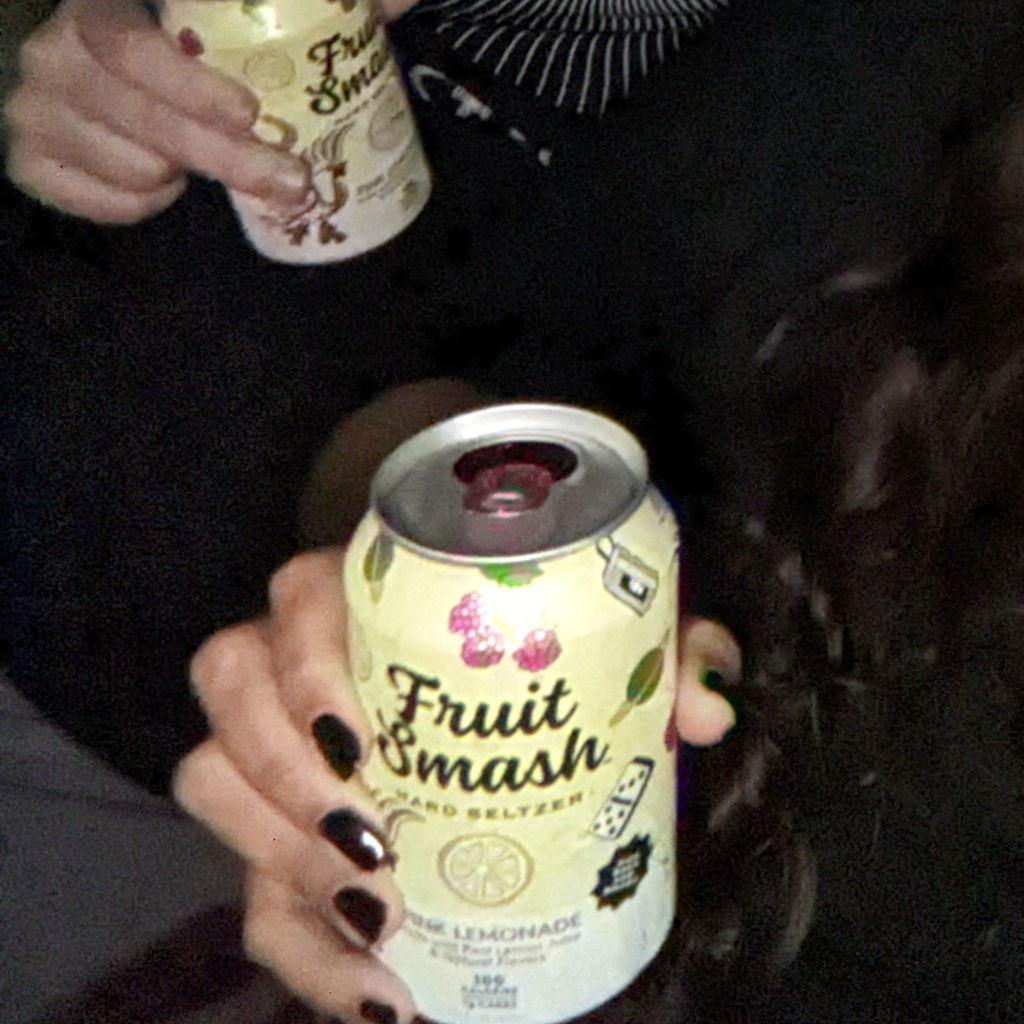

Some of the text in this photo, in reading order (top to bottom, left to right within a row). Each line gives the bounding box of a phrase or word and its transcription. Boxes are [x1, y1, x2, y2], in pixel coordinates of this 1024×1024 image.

[387, 664, 578, 739] Fruit
[376, 708, 611, 794] Smash
[466, 791, 583, 820] SELTZER
[453, 909, 582, 942] LEMONADE
